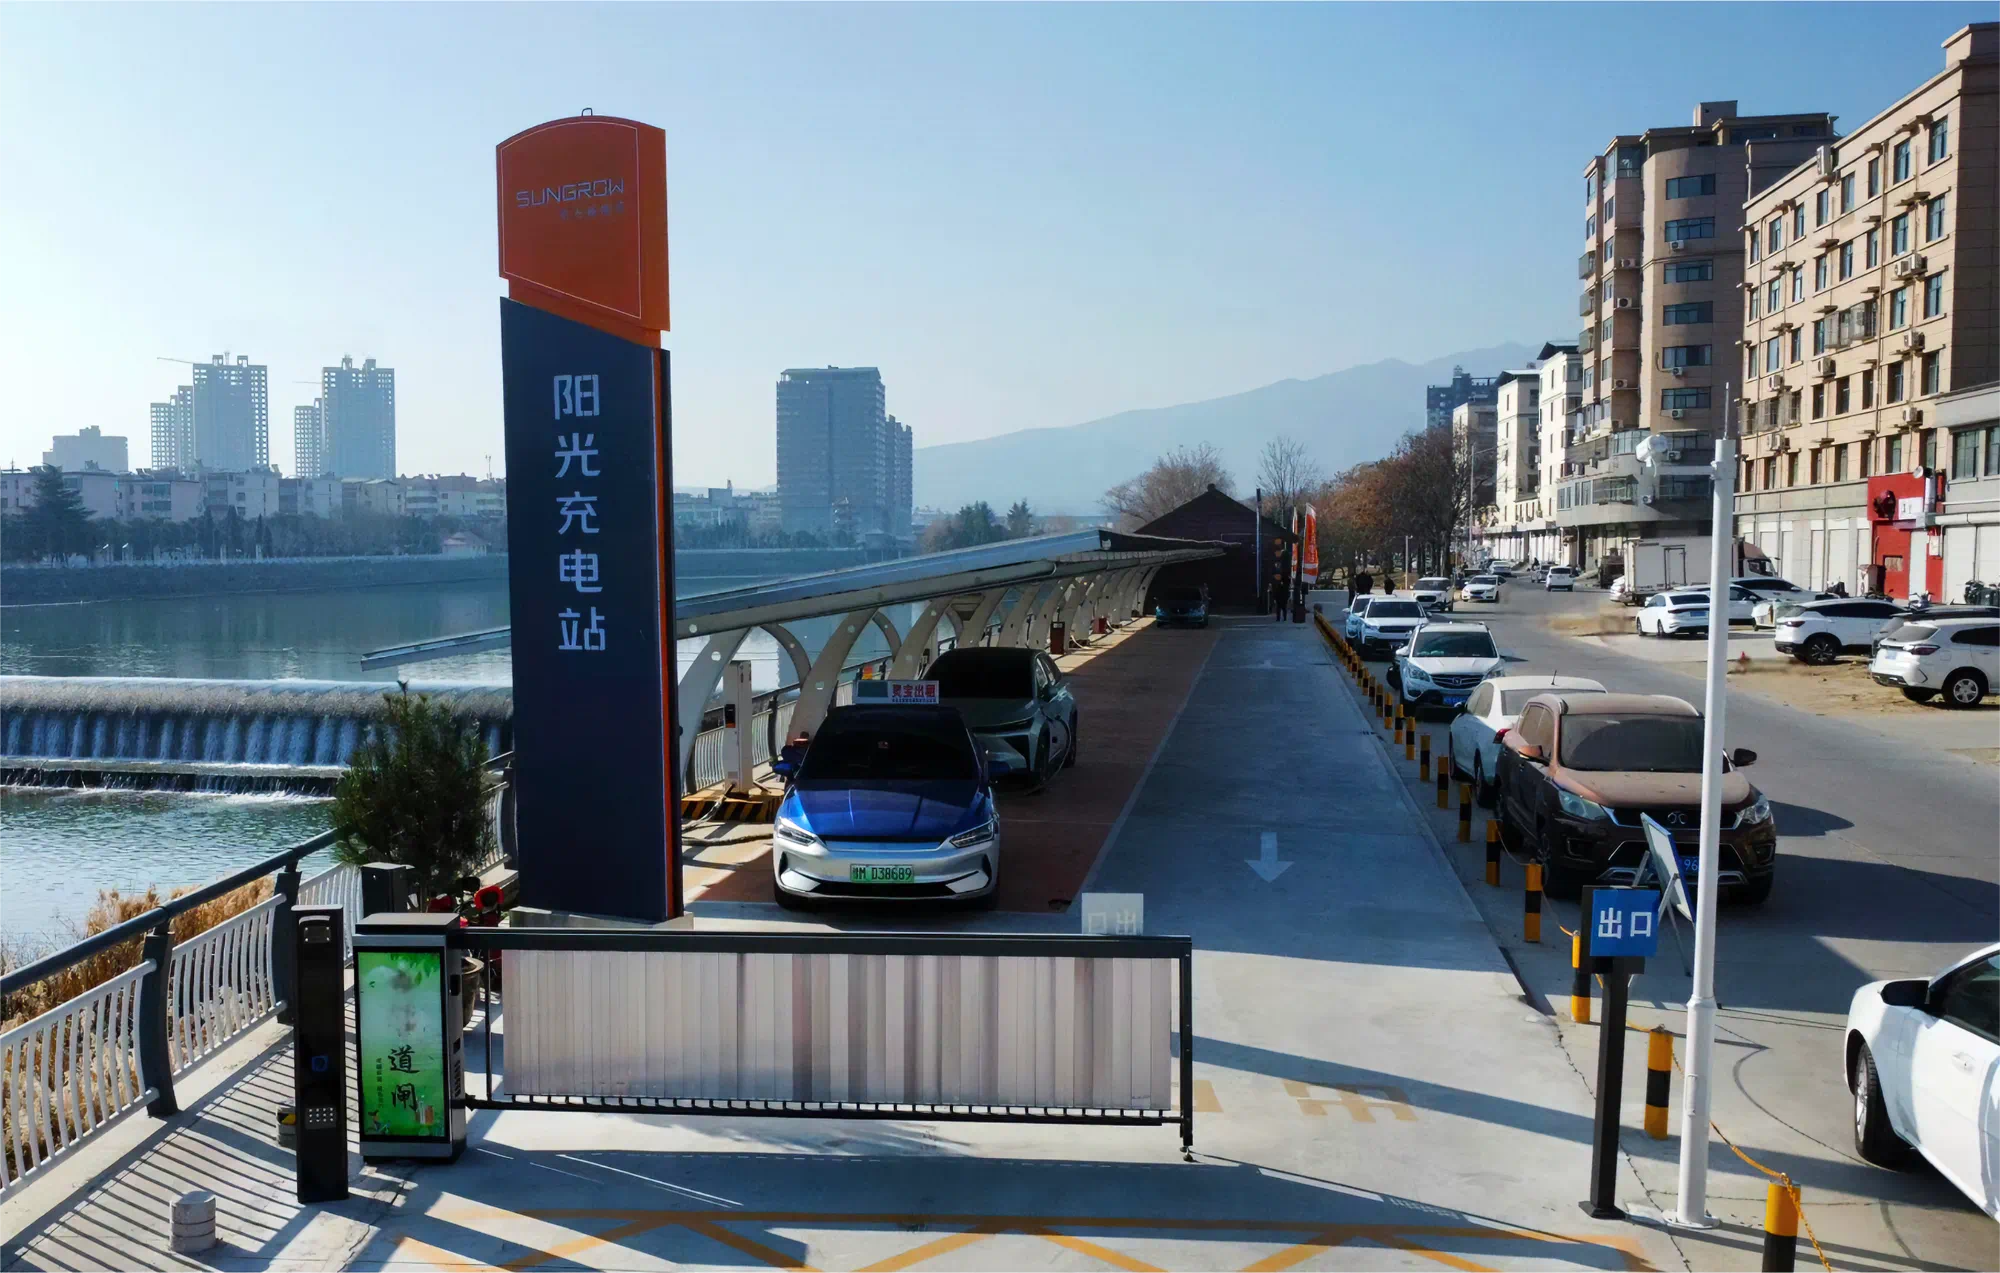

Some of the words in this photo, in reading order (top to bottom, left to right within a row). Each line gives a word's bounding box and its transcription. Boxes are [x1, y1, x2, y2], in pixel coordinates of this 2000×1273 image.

[516, 178, 624, 208] SUNGROW
[553, 374, 606, 651] 阳光充电站
[1597, 907, 1653, 940] 出口
[388, 1045, 420, 1112] 道闸
